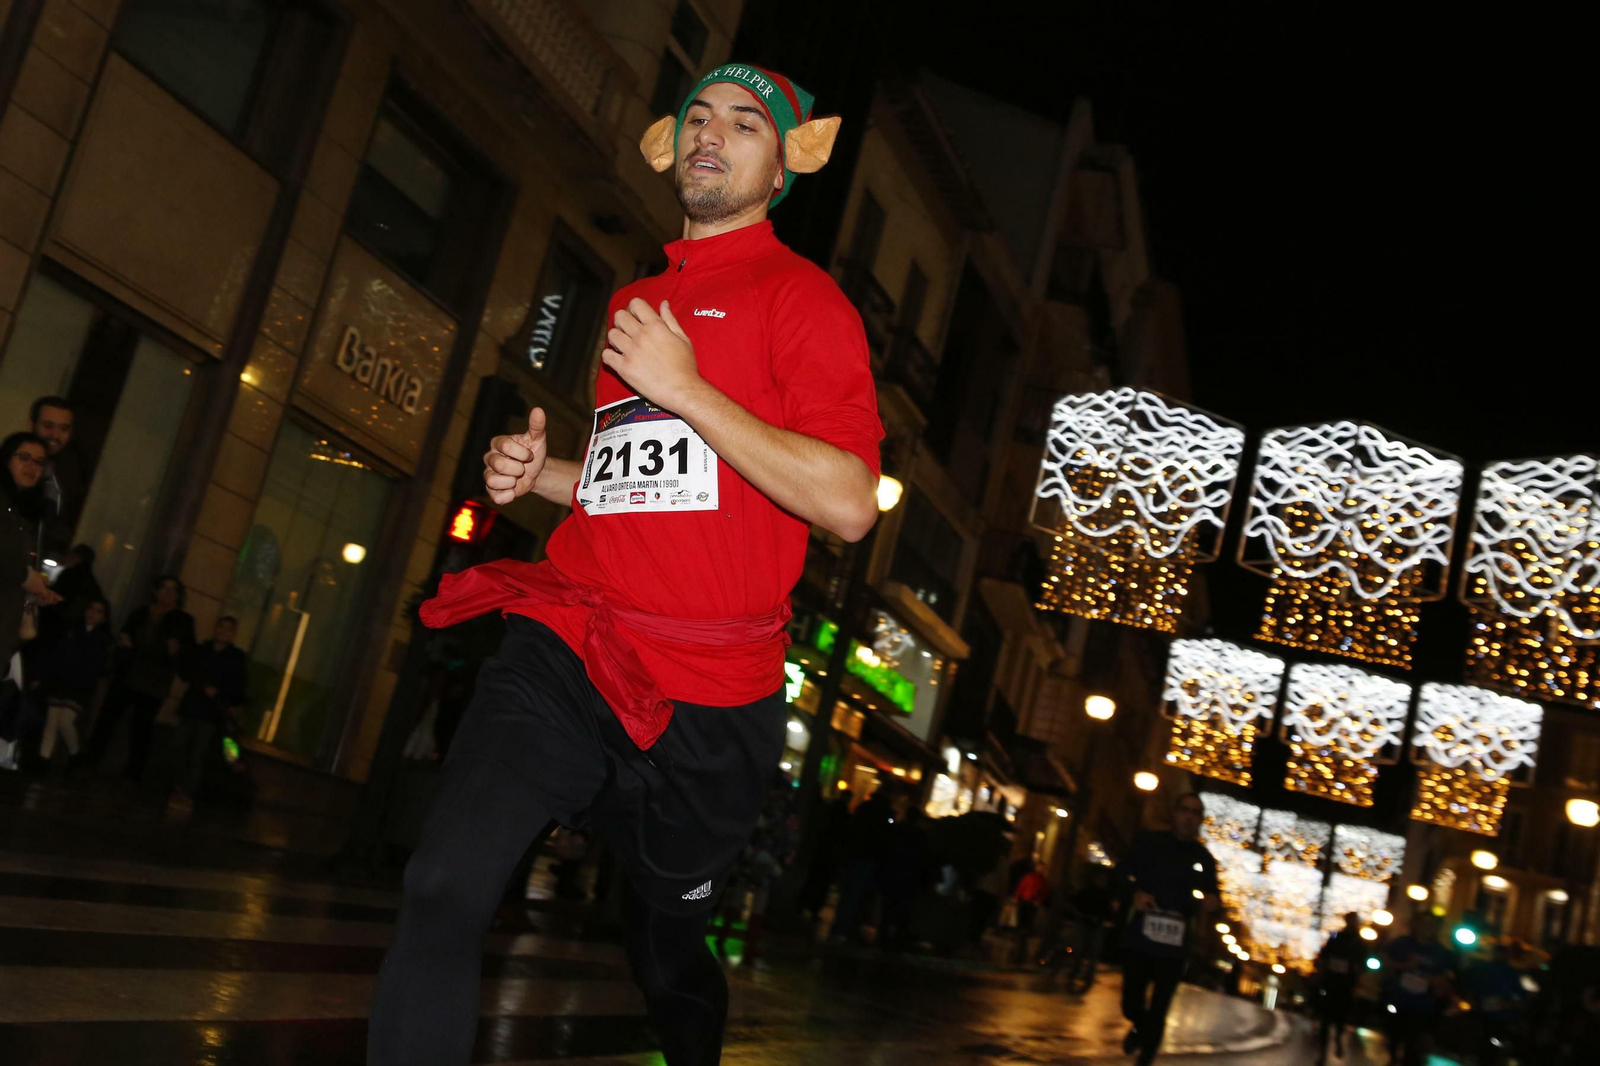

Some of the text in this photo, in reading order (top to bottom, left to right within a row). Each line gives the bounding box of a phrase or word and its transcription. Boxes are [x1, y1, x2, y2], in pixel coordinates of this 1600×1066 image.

[724, 66, 775, 99] HELPER
[336, 326, 423, 415] Bankia
[593, 437, 689, 483] 2131
[601, 479, 679, 493] ALVARO ORTEGA MARTIN (1990)
[681, 889, 713, 901] adidas
